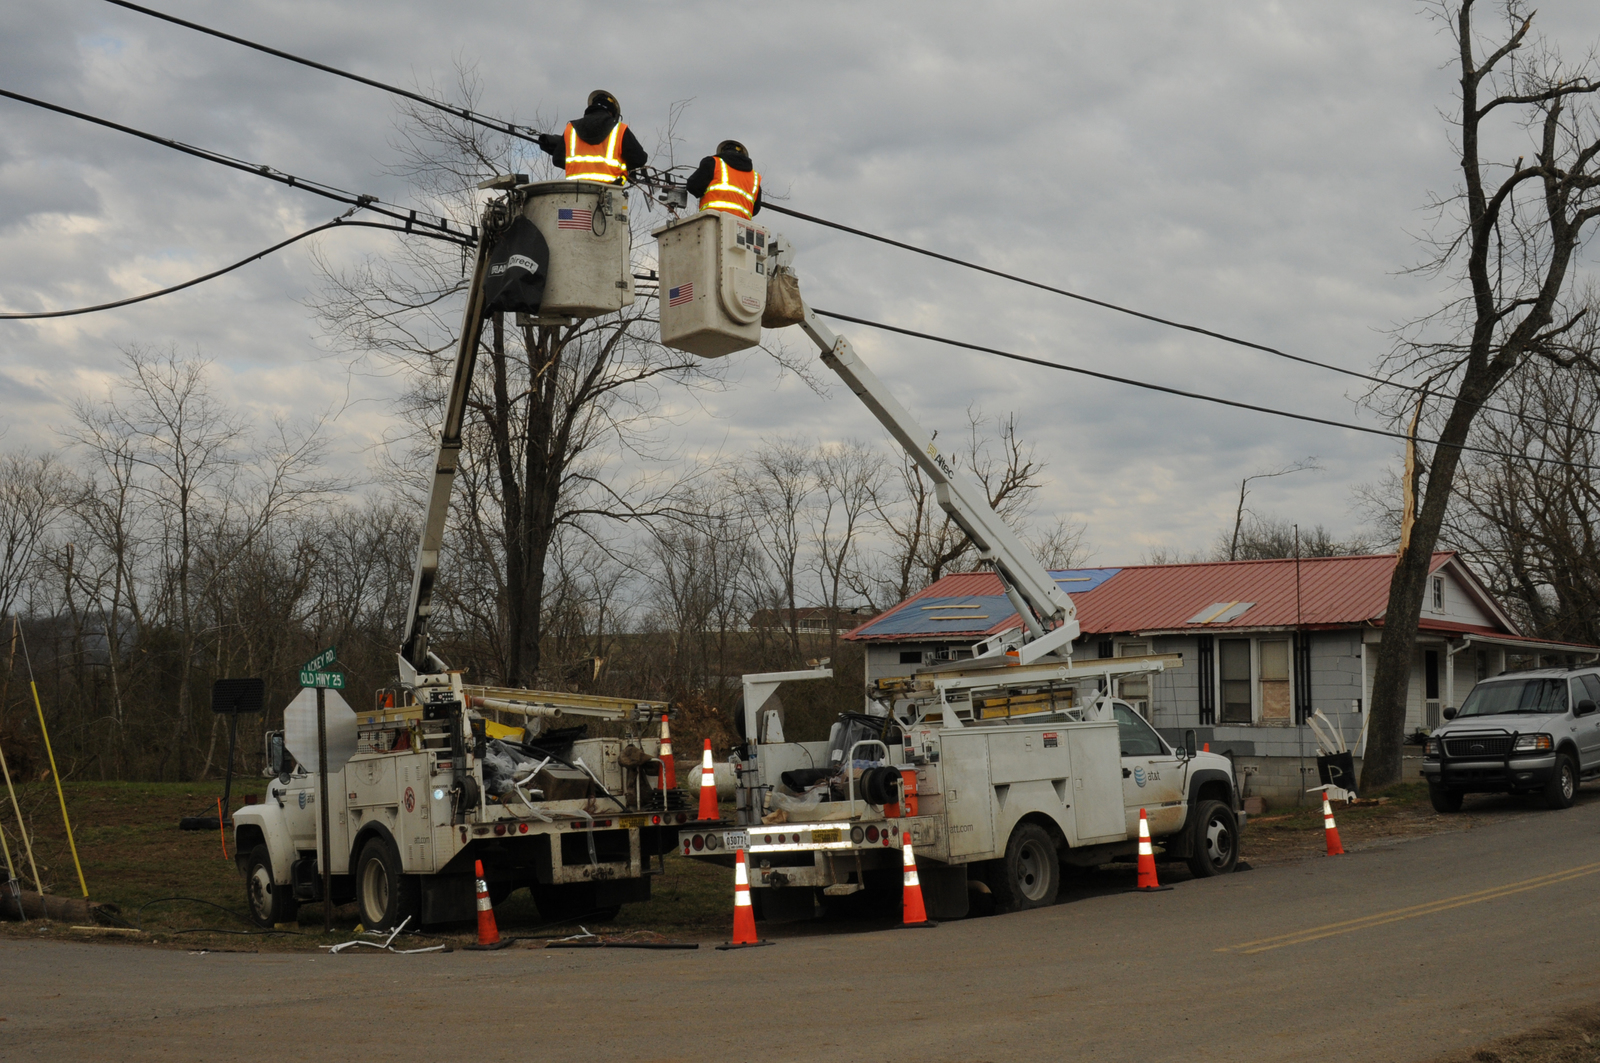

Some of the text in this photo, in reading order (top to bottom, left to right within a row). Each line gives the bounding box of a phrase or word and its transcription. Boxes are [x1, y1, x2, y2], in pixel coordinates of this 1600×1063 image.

[934, 454, 955, 480] Altec
[301, 672, 342, 686] OLD HWY 25
[950, 823, 974, 833] att.com
